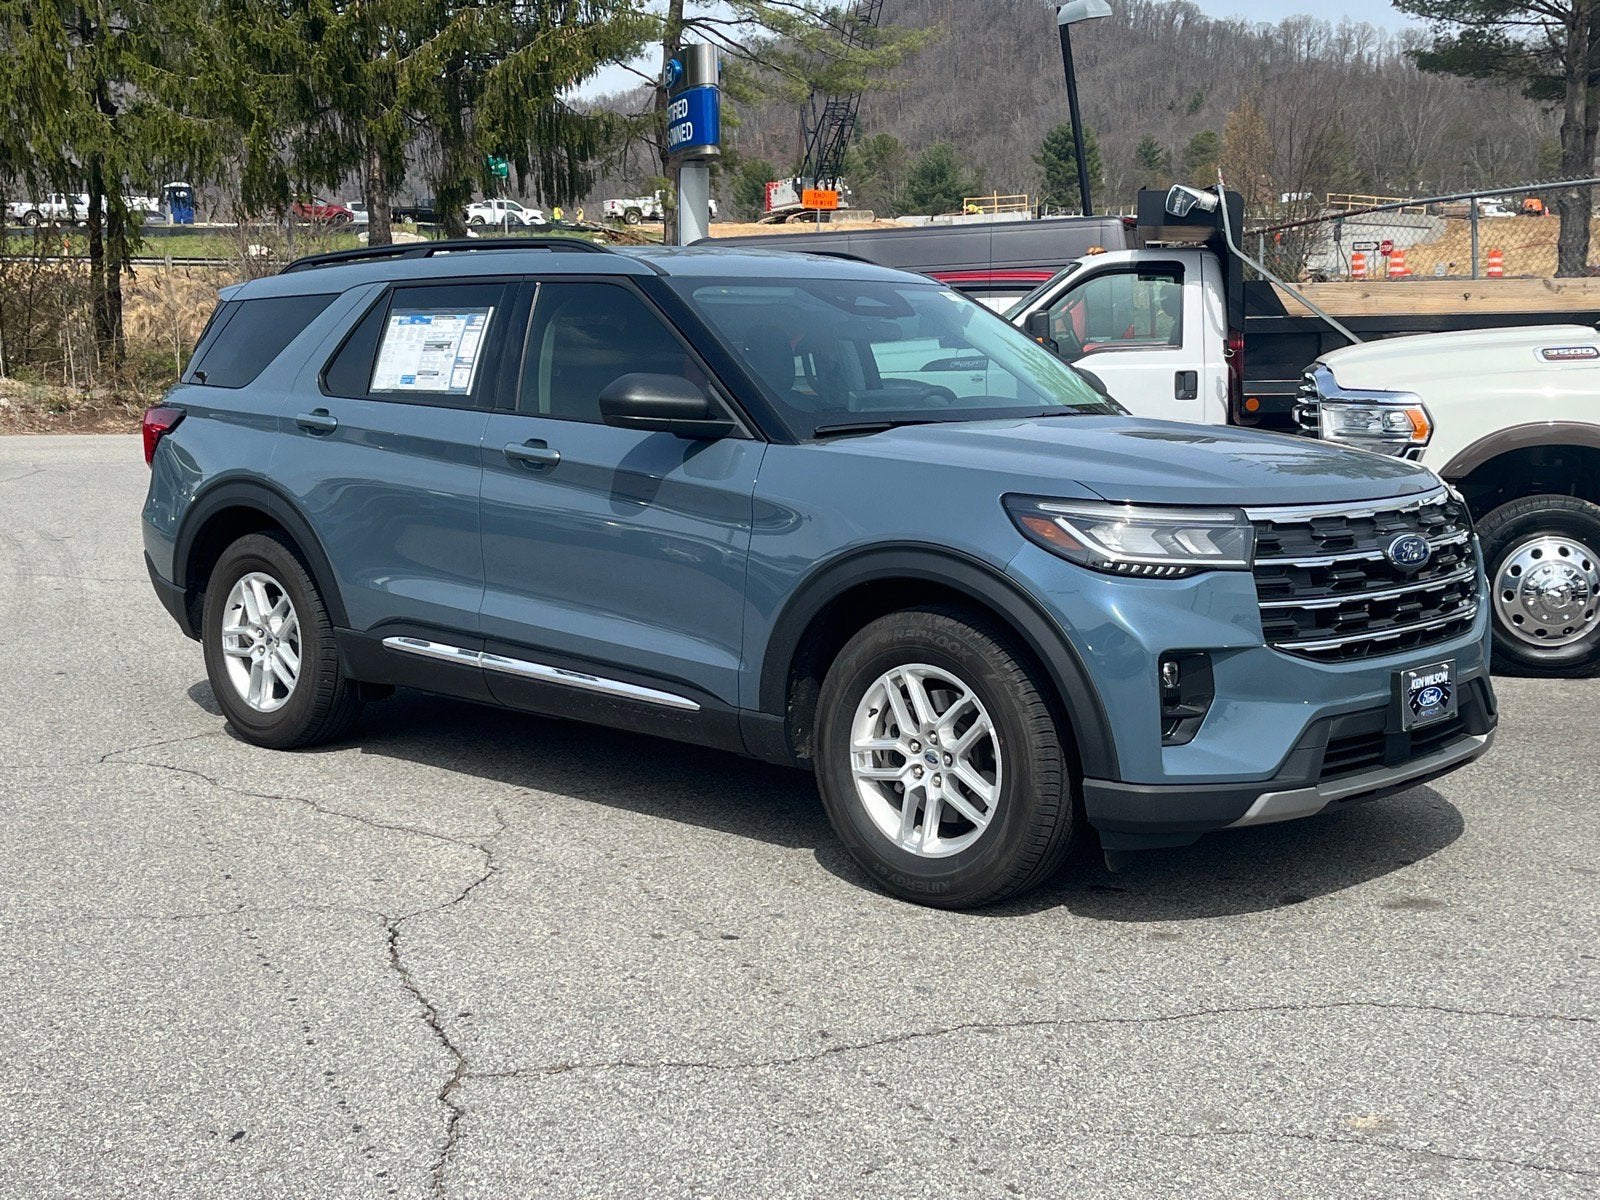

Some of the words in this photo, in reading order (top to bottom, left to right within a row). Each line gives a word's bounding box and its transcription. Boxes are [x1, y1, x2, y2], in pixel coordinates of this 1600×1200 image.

[1402, 541, 1426, 562] Ford
[1411, 677, 1425, 690] KEN
[1424, 670, 1449, 687] WILSON
[1422, 689, 1440, 705] Ford
